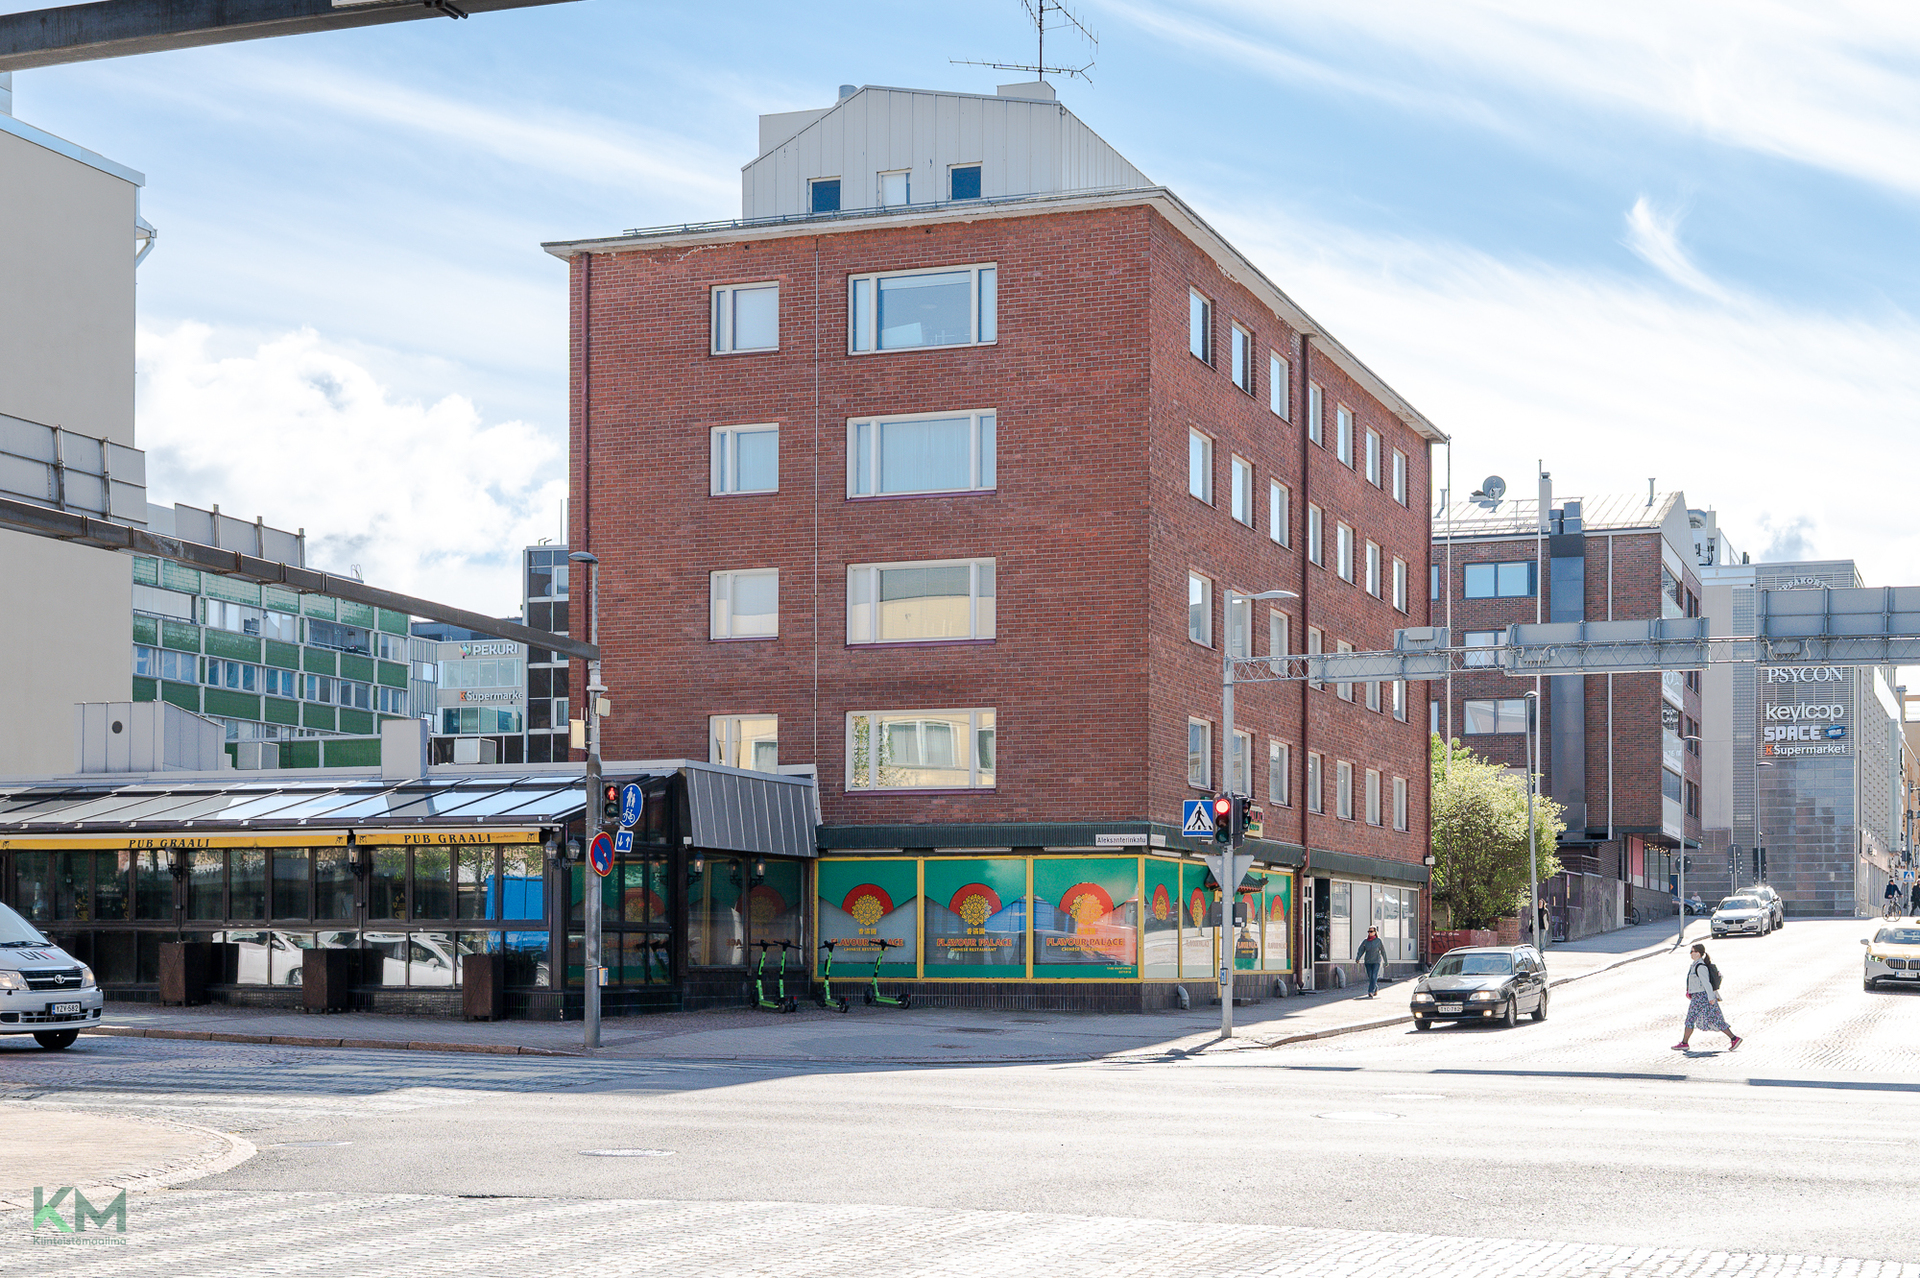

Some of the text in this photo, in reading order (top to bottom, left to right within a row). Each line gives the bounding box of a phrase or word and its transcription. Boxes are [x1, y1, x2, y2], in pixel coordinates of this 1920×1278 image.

[473, 644, 518, 656] PEKURI
[1767, 667, 1843, 683] PSYCON
[467, 690, 523, 702] Supermarke
[1766, 702, 1844, 722] keyloop
[1764, 725, 1822, 741] SPACE
[129, 838, 210, 849] PUB GRAALI
[404, 833, 492, 844] PUB GRAALI
[871, 938, 904, 946] PAACE
[937, 938, 1012, 946] FLAVOUR PALACE
[1046, 937, 1123, 946] FLAVOUR PALACE
